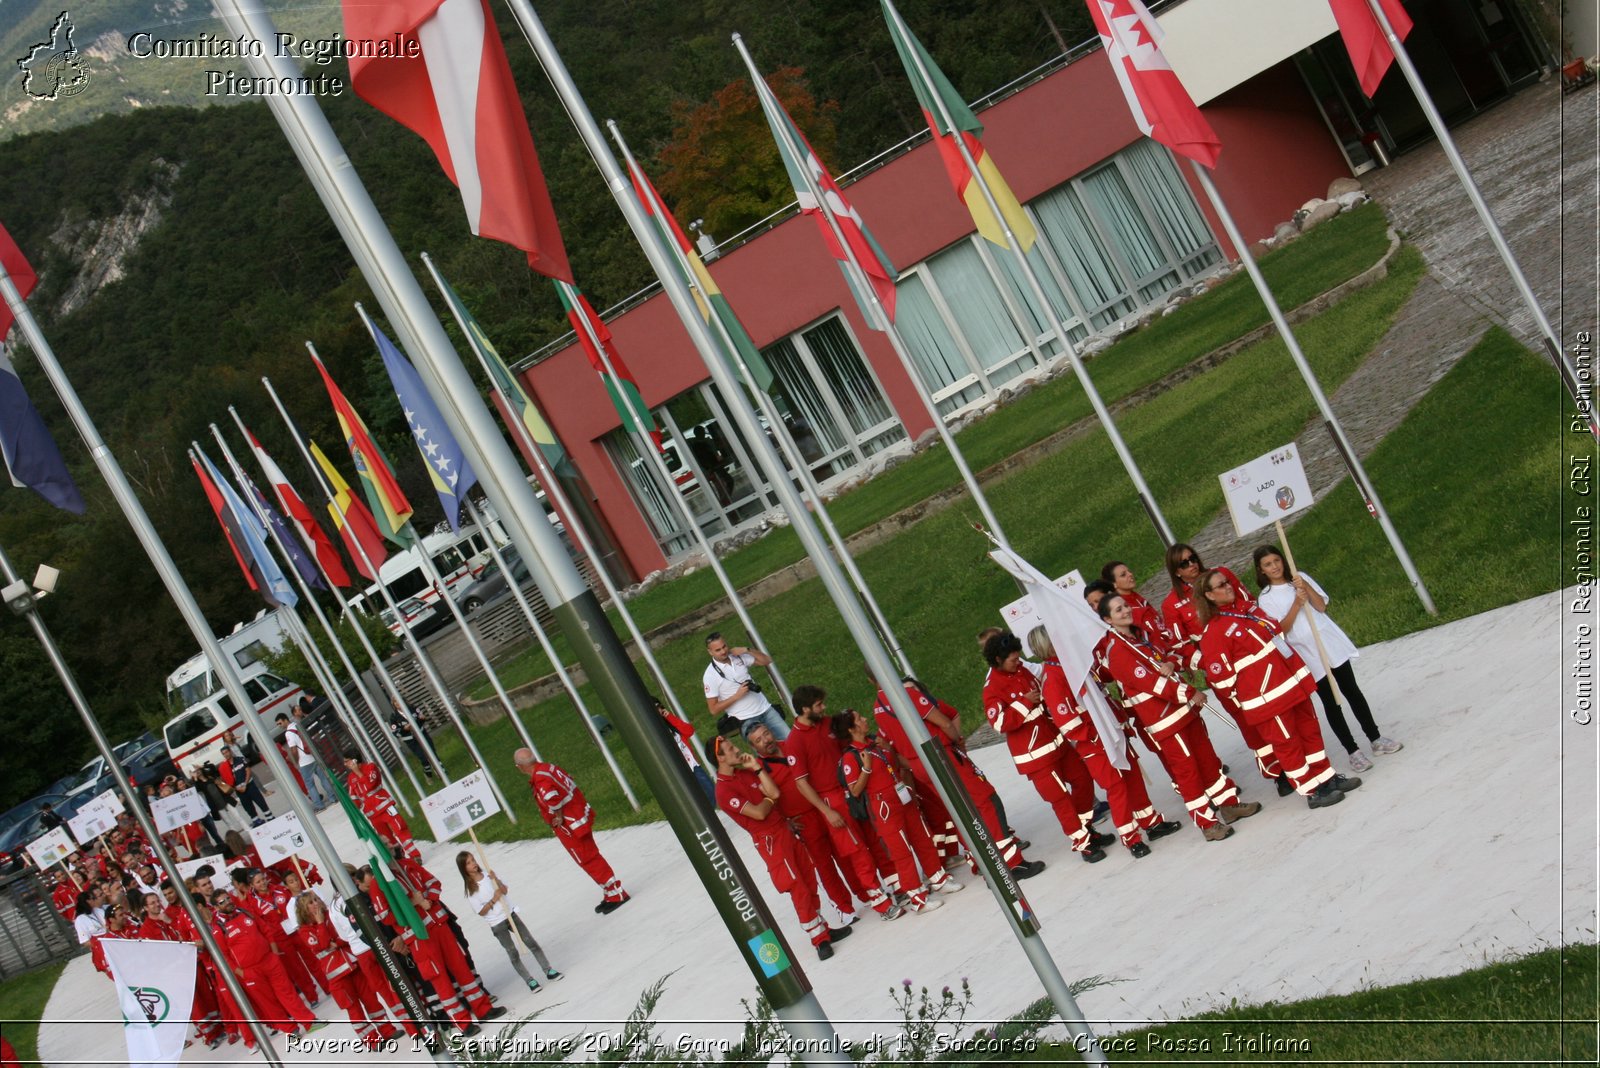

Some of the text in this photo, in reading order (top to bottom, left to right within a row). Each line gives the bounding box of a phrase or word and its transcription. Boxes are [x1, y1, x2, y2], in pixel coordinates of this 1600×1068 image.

[1256, 479, 1275, 492] LAZIO
[443, 794, 474, 814] LOMBARDIA
[695, 827, 757, 922] ROM-SINTI
[972, 817, 1017, 895] REPUBBLICA CECA
[373, 936, 425, 1022] REPUBBLICA DOMINICANA
